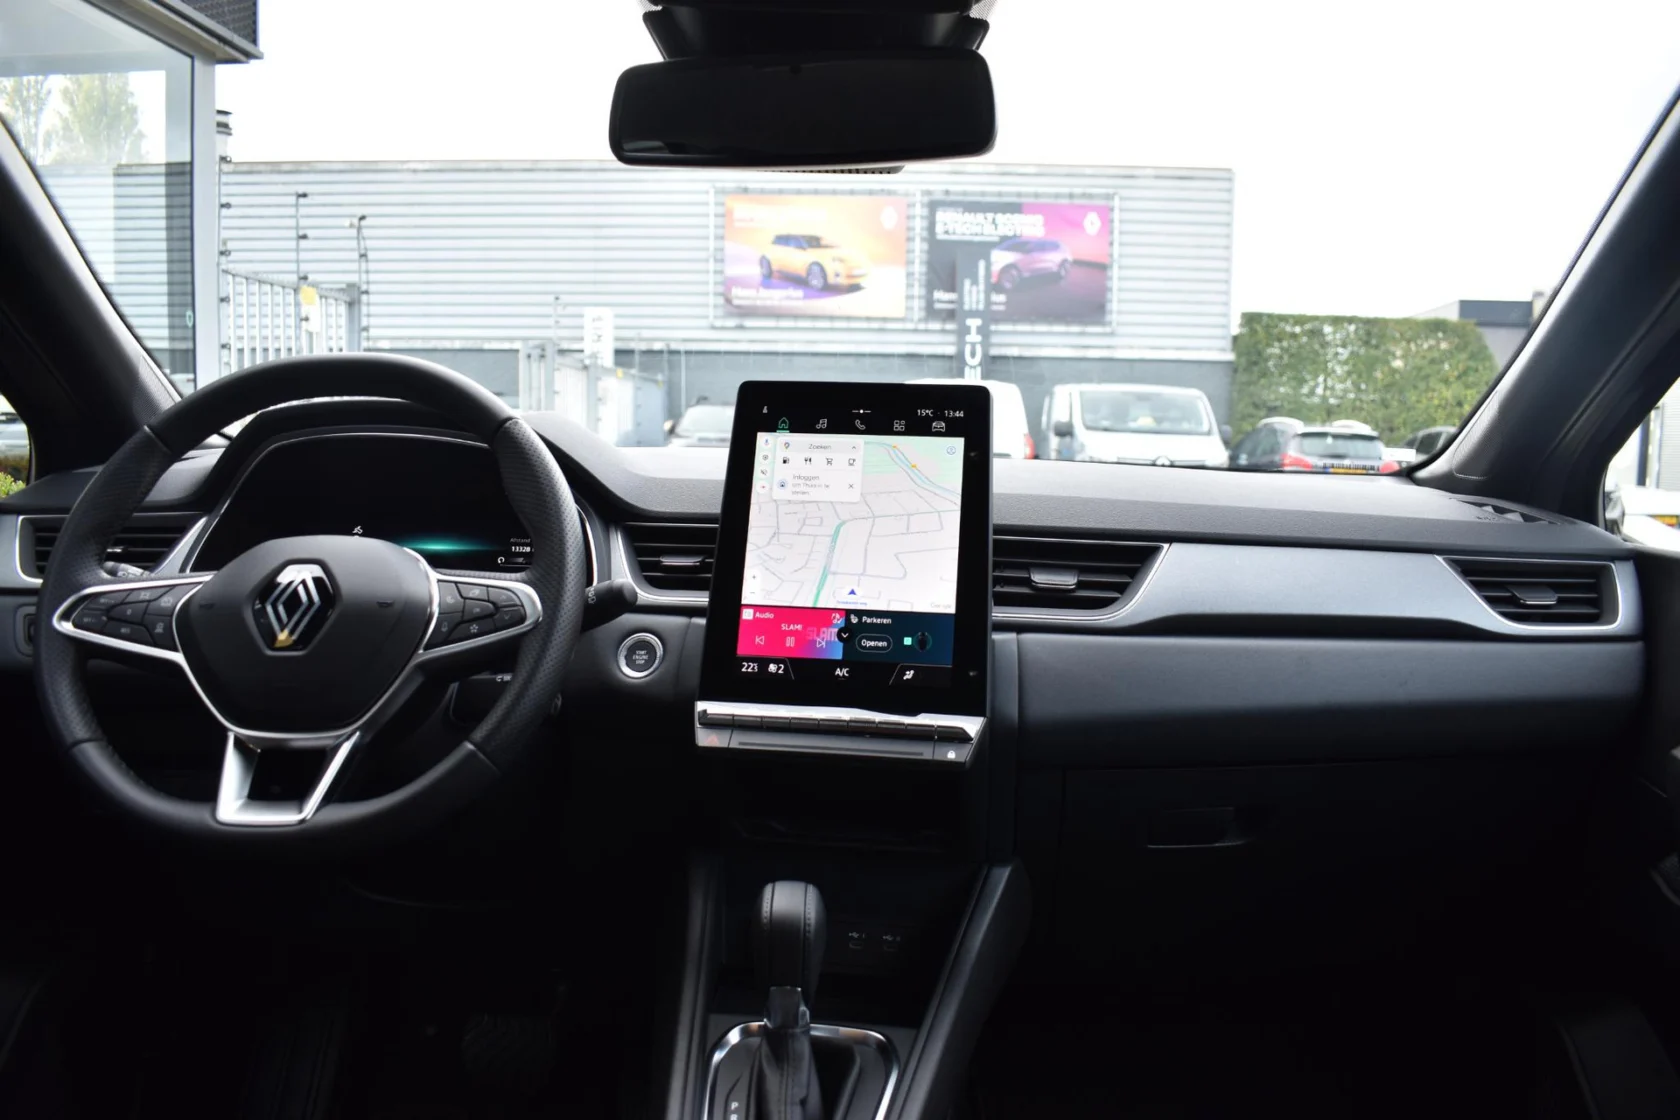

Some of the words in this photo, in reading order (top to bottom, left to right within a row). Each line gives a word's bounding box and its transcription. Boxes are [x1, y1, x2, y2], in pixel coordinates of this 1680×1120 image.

[792, 474, 820, 482] Inloggen
[755, 611, 774, 619] Audio
[862, 616, 892, 624] Parkeren
[781, 623, 803, 631] SLAM!
[861, 639, 888, 648] Openen
[778, 664, 785, 673] 2
[835, 668, 849, 676] A/C
[731, 1101, 739, 1110] P
